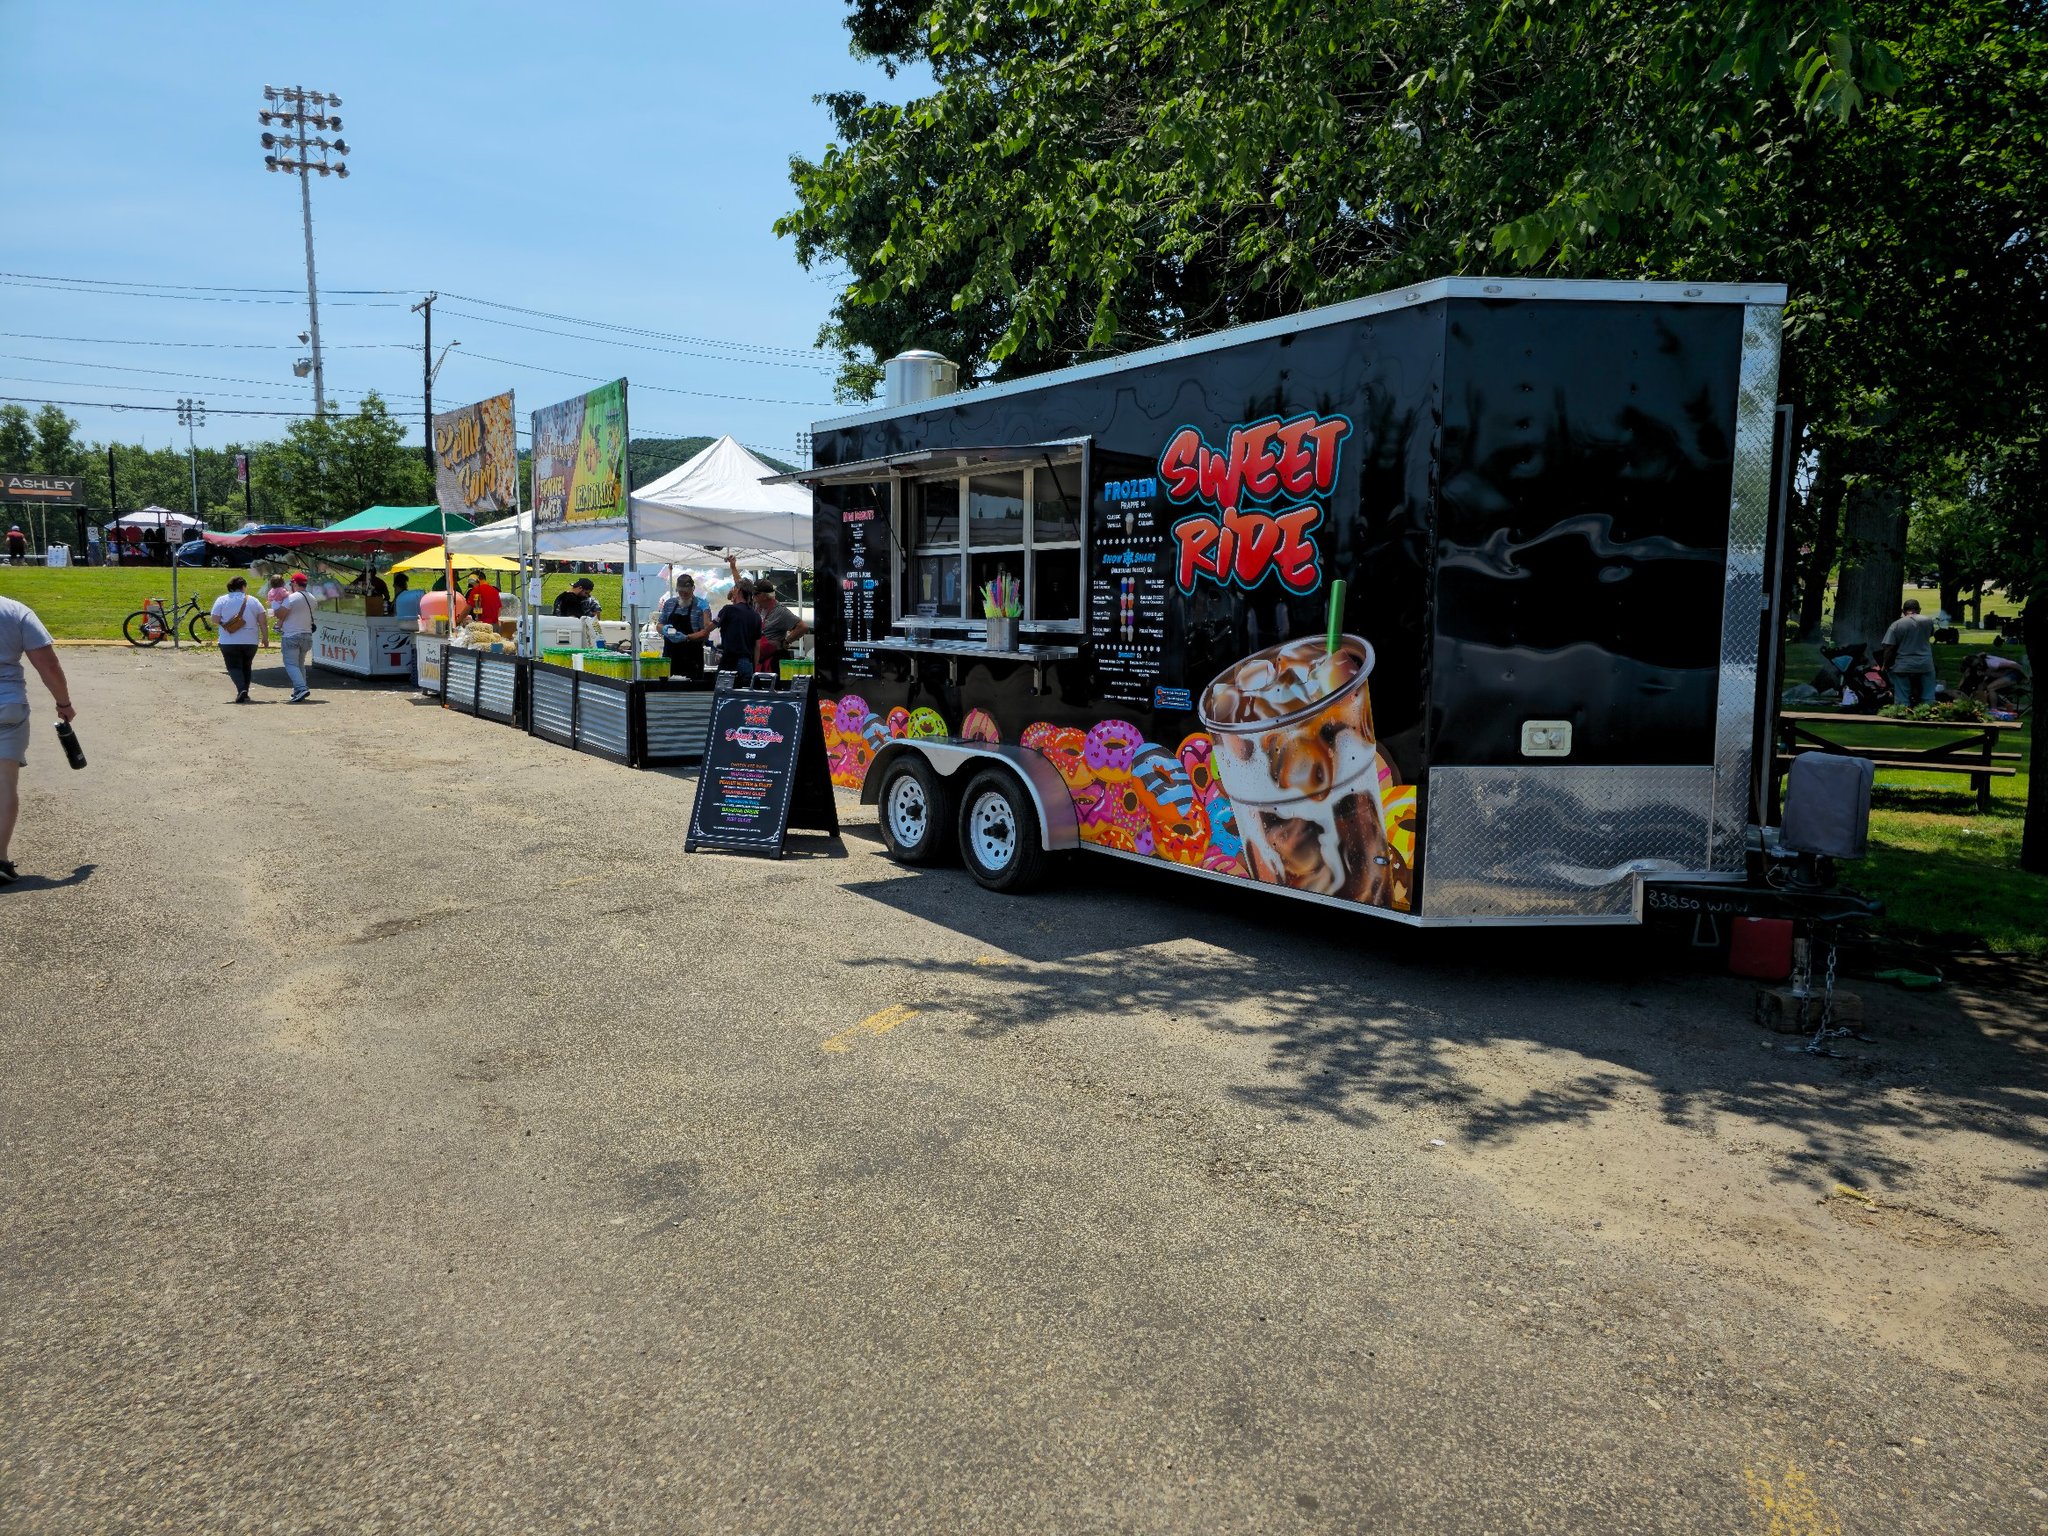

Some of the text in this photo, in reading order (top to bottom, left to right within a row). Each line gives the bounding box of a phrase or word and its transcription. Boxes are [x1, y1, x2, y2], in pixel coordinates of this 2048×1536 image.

[1160, 415, 1349, 508] SWEET
[8, 477, 75, 490] ASHLEY
[1104, 478, 1157, 501] FROZEN
[1120, 501, 1139, 510] FRAPPE
[1102, 552, 1156, 564] SNOW SHAKE
[320, 626, 358, 647] Fowler's
[320, 643, 359, 663] TAFFY
